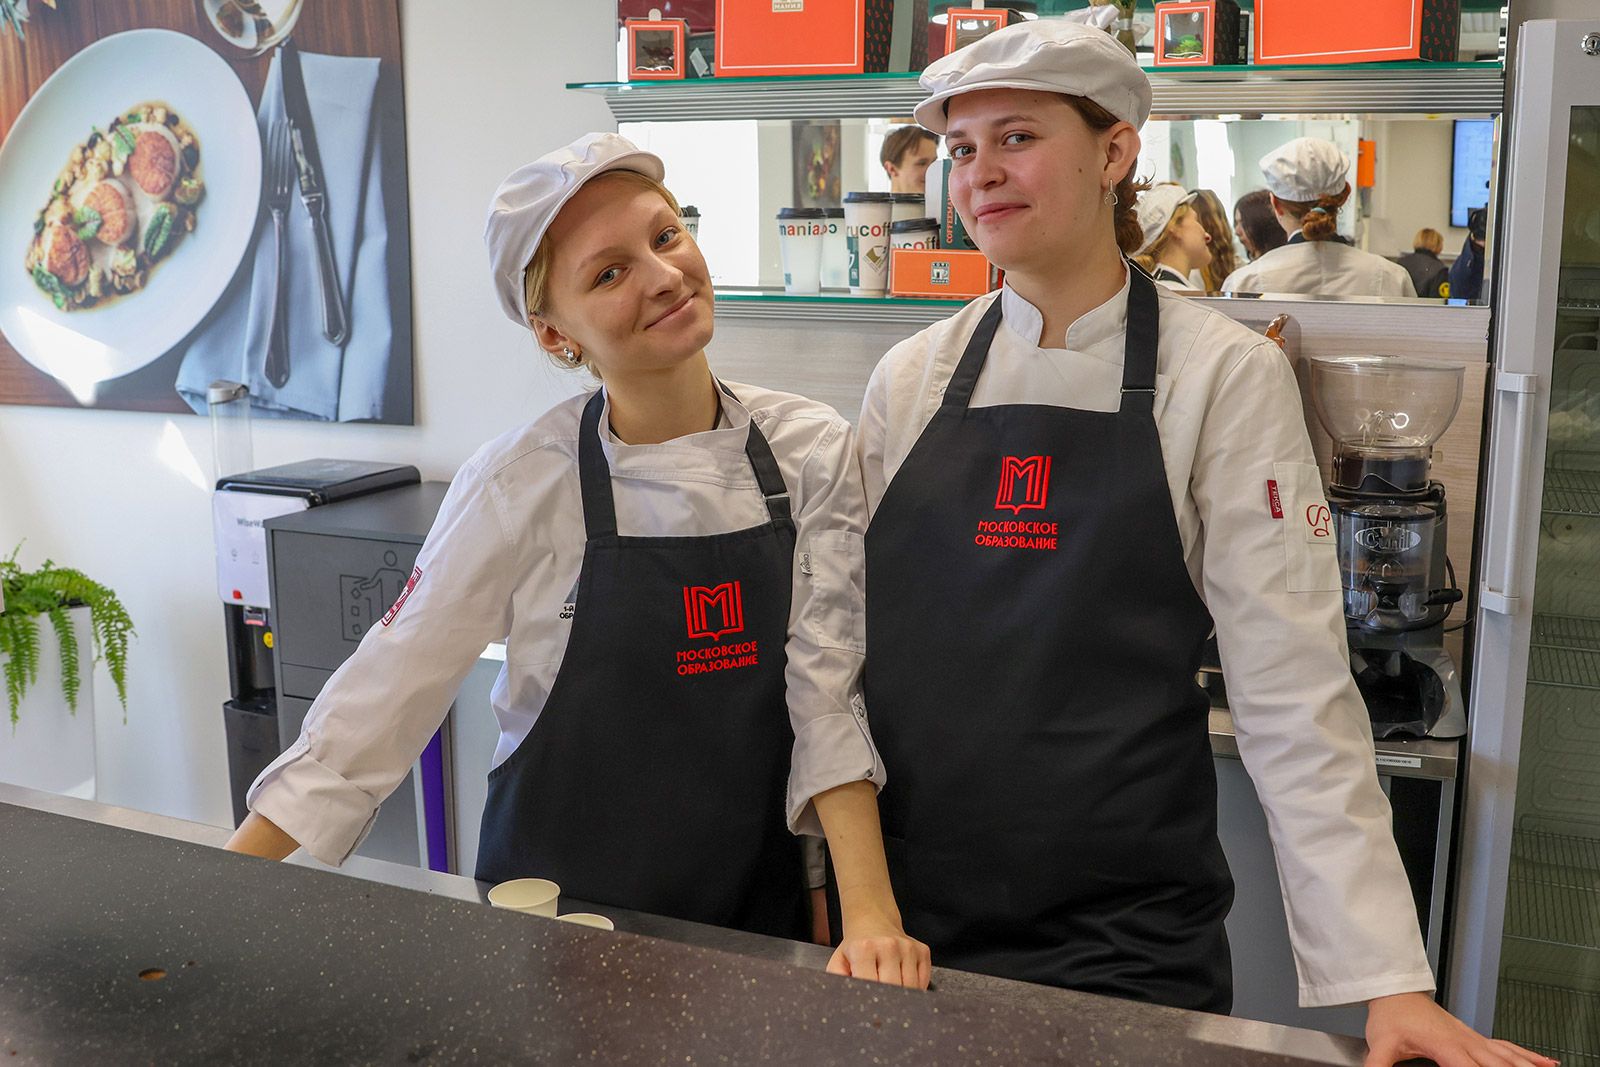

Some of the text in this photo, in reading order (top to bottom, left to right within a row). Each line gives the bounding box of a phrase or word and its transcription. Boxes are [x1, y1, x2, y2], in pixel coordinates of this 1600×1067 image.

[977, 520, 1058, 535] МОСКОВСКОЕ
[975, 534, 1057, 550] ОБРАЗОВАНИЕ
[676, 641, 758, 662] МОСКОВСКОЕ
[677, 654, 759, 675] ОБРАЗОВАНИЕ
